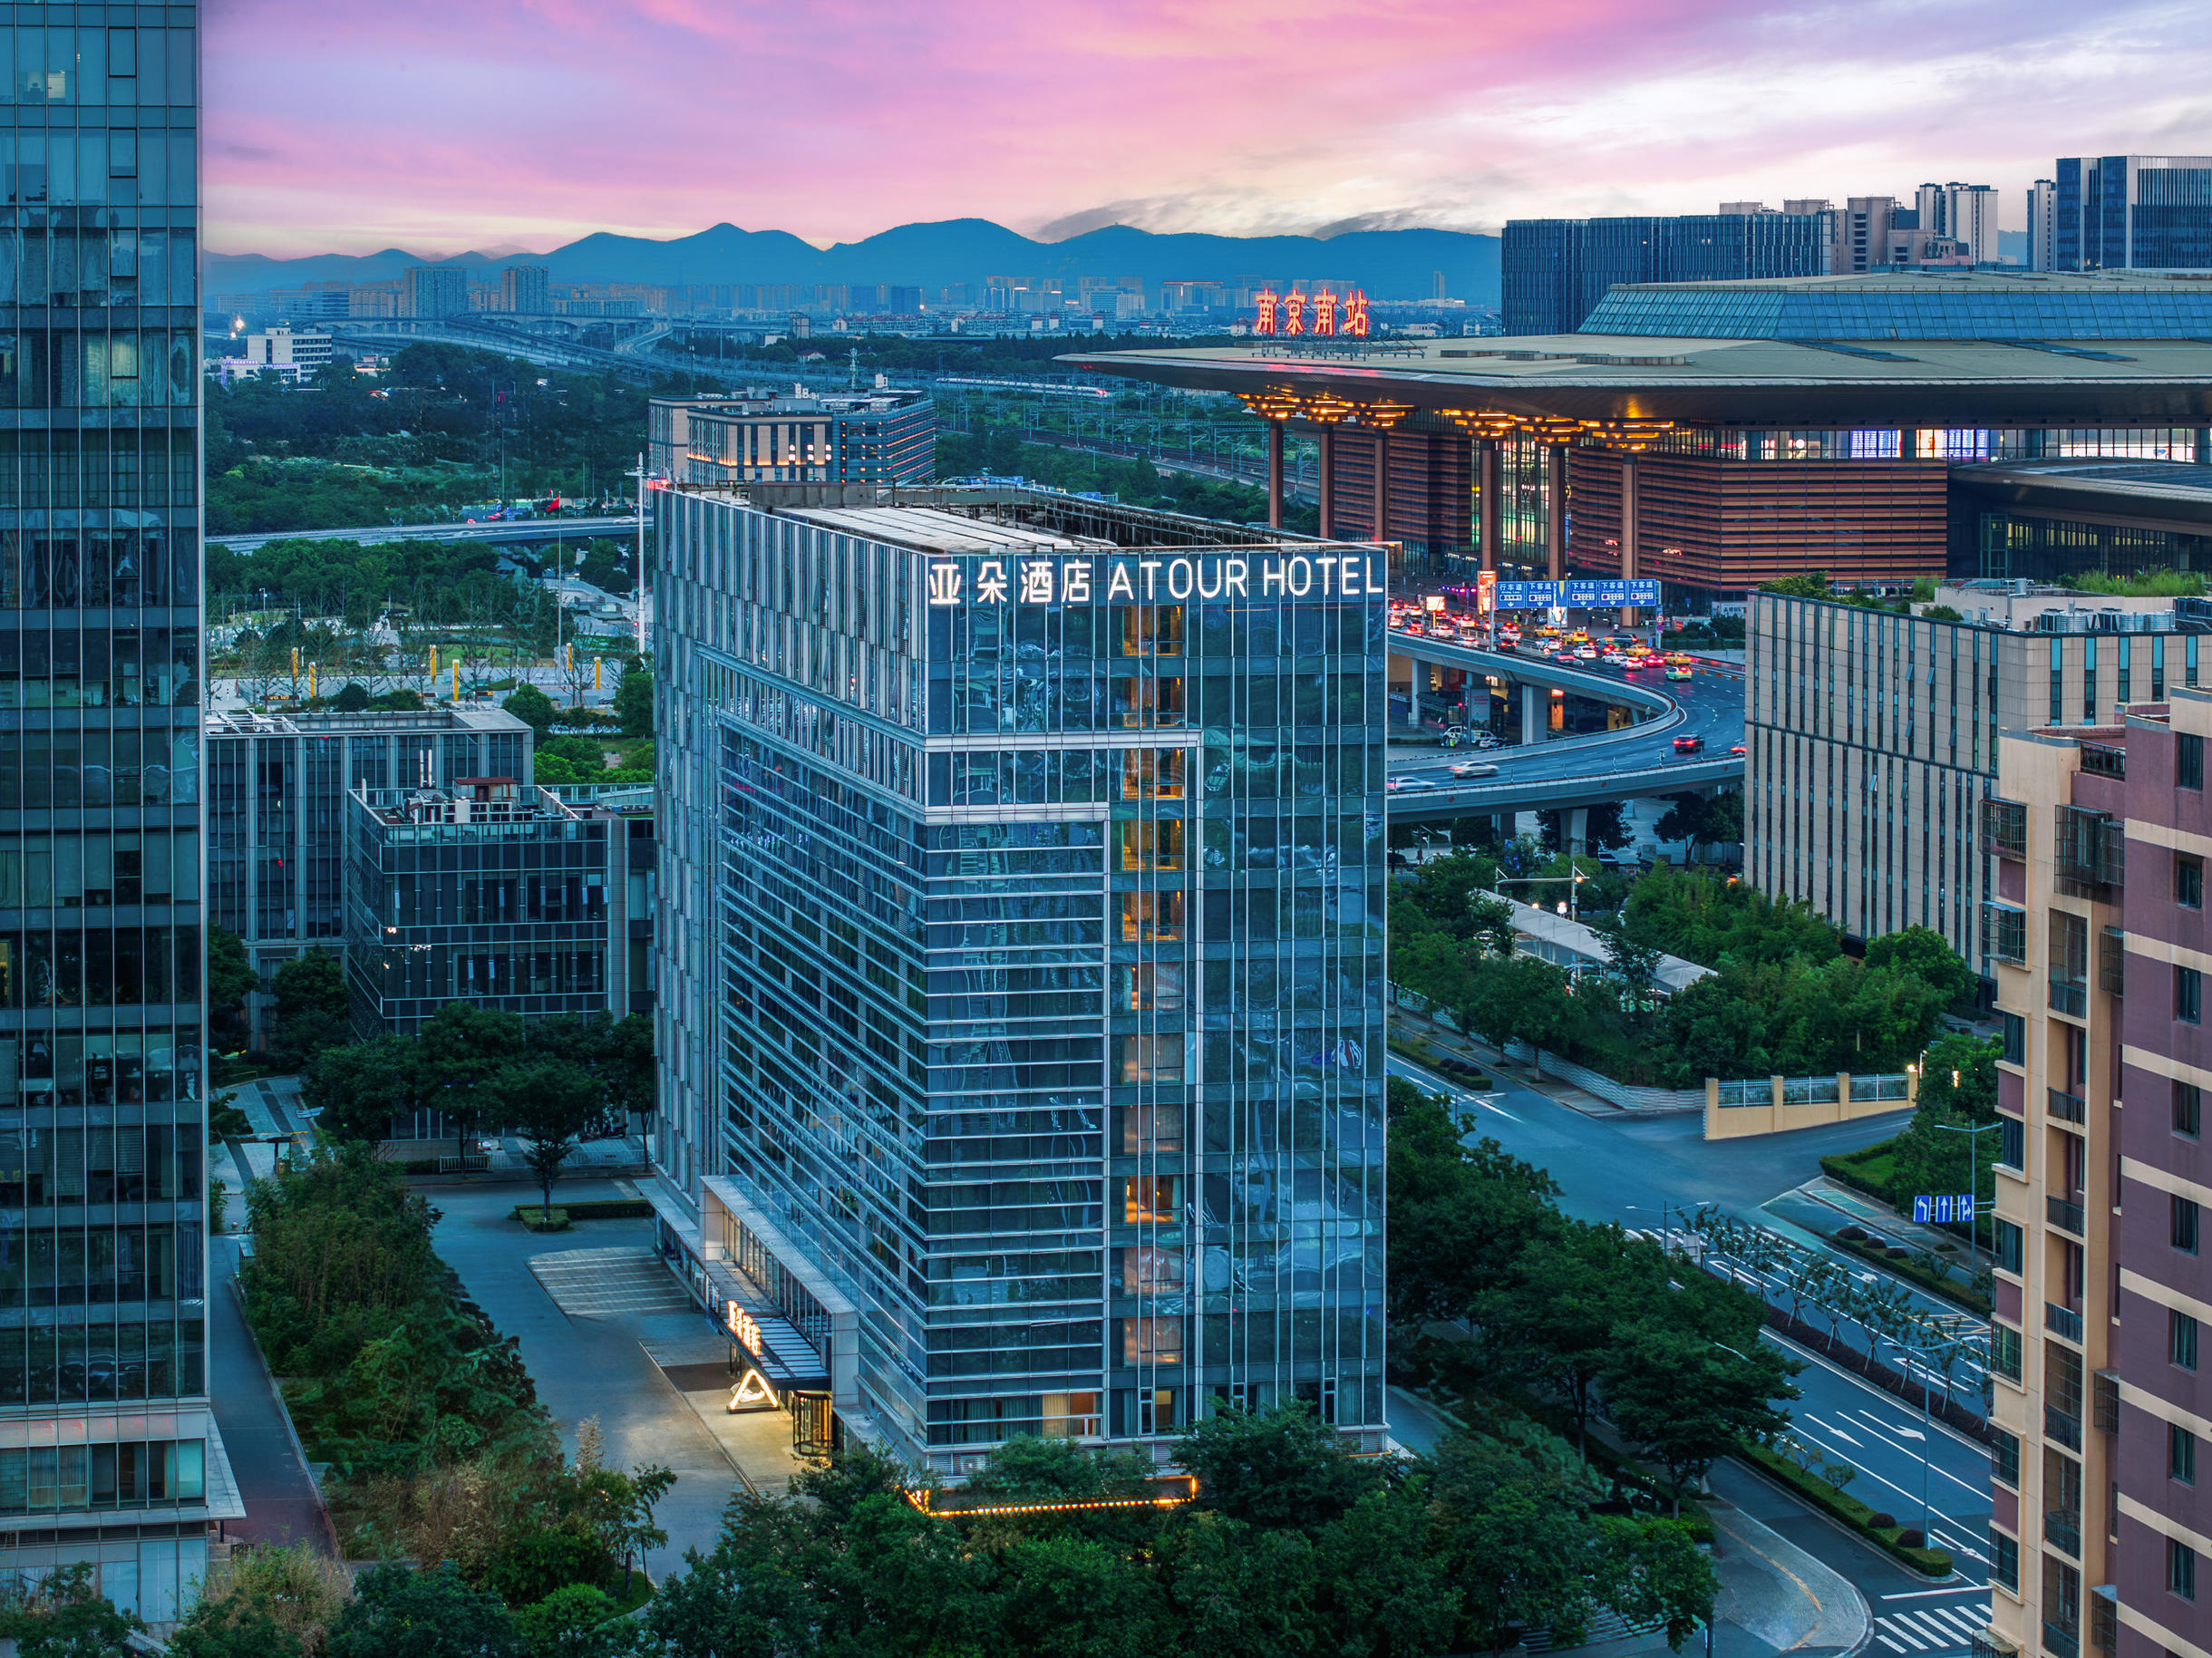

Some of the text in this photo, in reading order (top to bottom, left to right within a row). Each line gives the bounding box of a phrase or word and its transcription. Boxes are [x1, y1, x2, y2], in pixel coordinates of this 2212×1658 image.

[1256, 286, 1369, 337] 南京南站
[929, 556, 1383, 605] 亚朵酒店 ATOUR HOTEL
